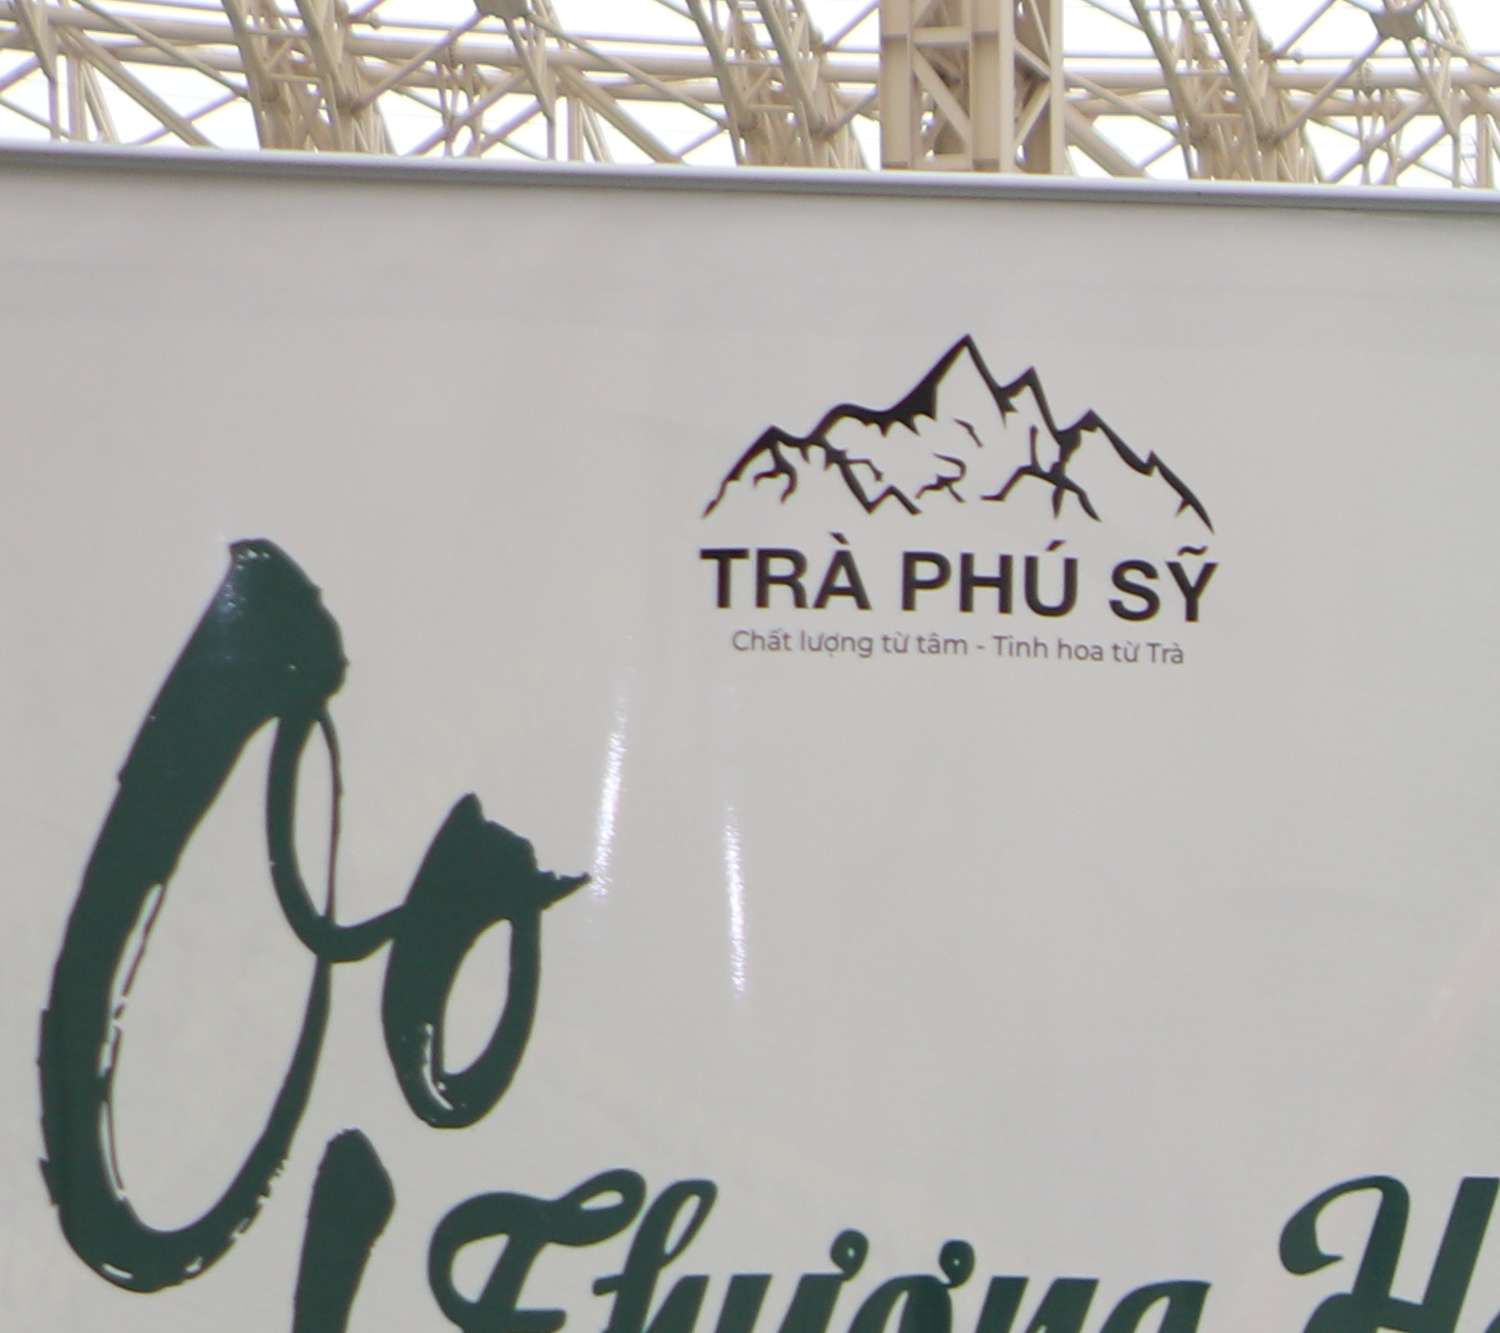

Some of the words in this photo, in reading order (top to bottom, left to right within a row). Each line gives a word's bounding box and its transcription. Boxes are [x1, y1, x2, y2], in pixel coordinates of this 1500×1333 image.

[701, 532, 872, 611] TRÀ
[901, 539, 1079, 618] PHÚ
[1108, 545, 1219, 624] SỸ
[732, 629, 791, 653] Chất
[800, 631, 873, 658] lượng
[881, 634, 908, 654] từ
[917, 633, 967, 656] tâm
[1058, 637, 1103, 662] hoa
[1112, 642, 1138, 663] từ
[1148, 642, 1185, 664] Trà
